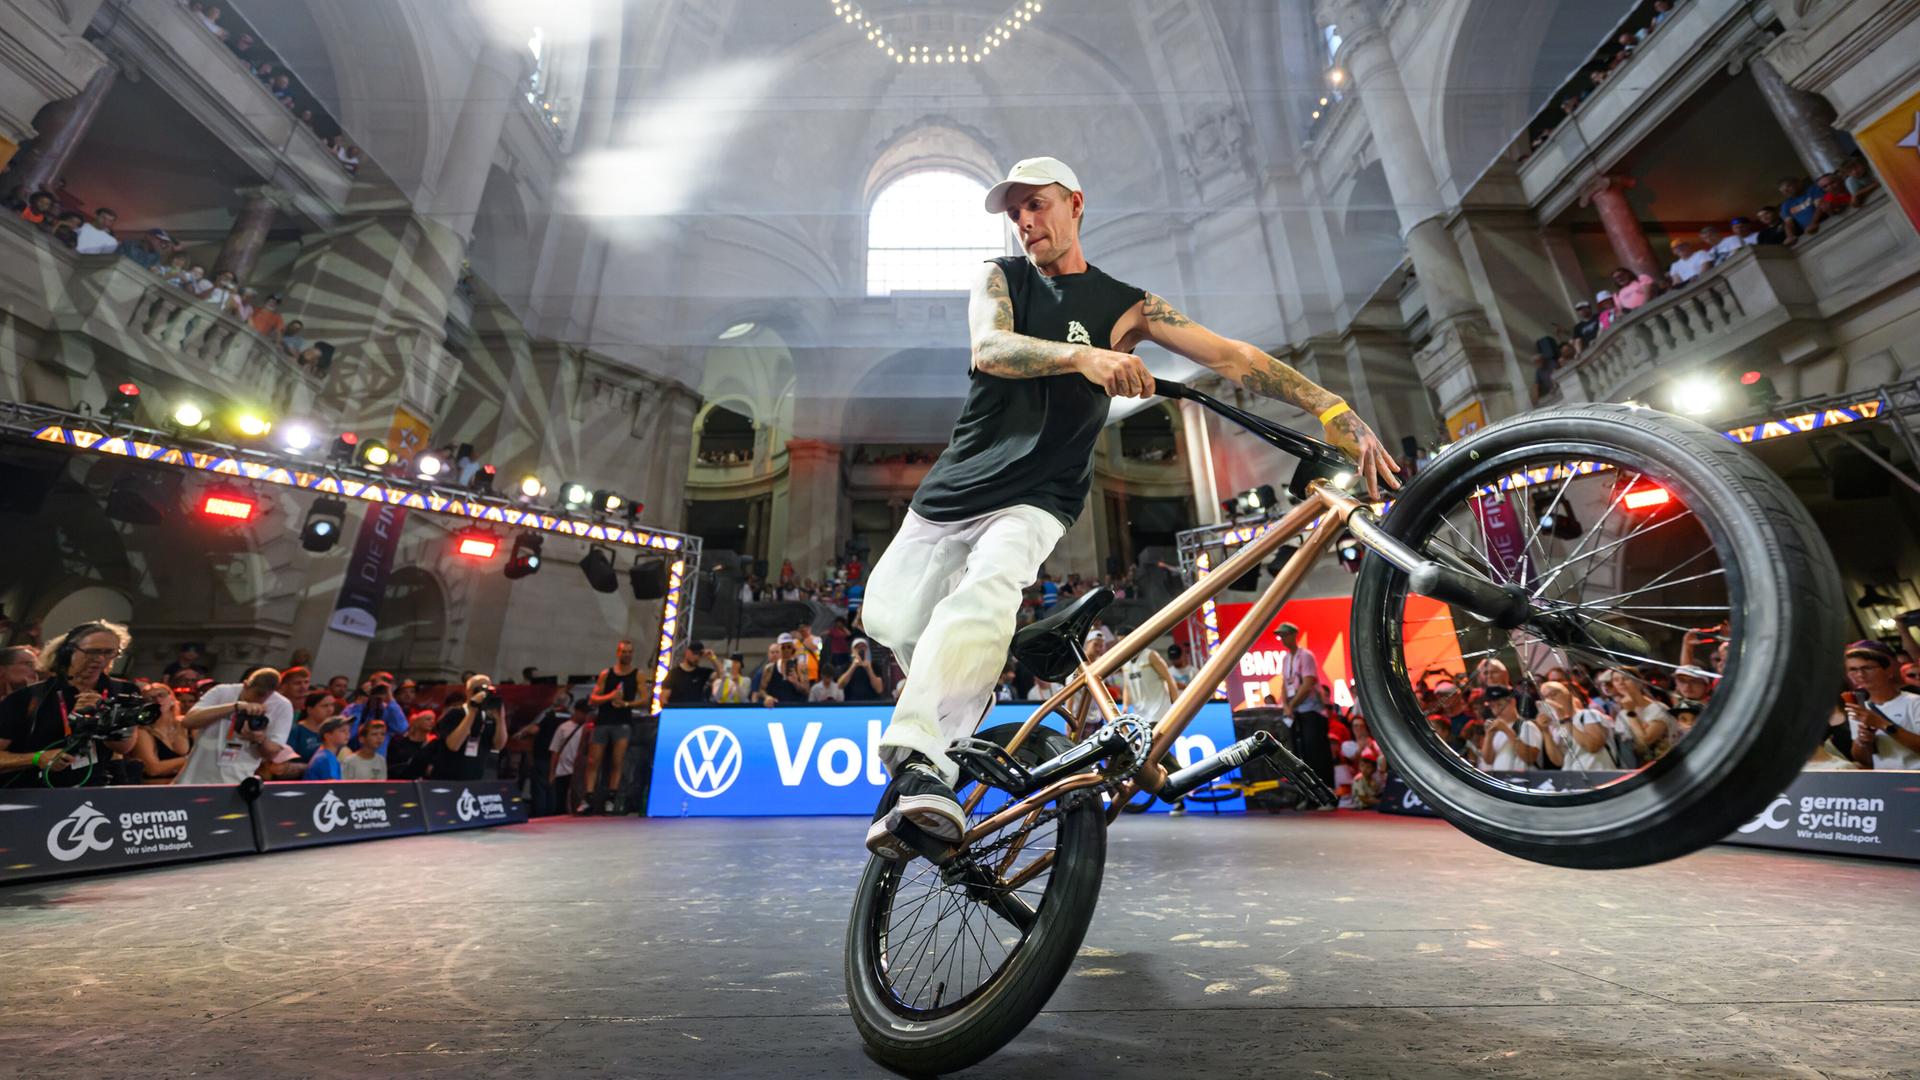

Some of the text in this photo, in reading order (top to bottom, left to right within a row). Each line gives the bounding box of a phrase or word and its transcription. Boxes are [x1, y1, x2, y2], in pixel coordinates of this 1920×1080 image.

[360, 541, 382, 583] DIE
[1799, 796, 1885, 813] german
[119, 809, 188, 829] german
[1797, 811, 1878, 833] cycling
[122, 824, 188, 845] cycling
[1796, 829, 1881, 844] Wir sind Radsport.
[124, 845, 140, 855] Wir
[141, 843, 158, 853] sind
